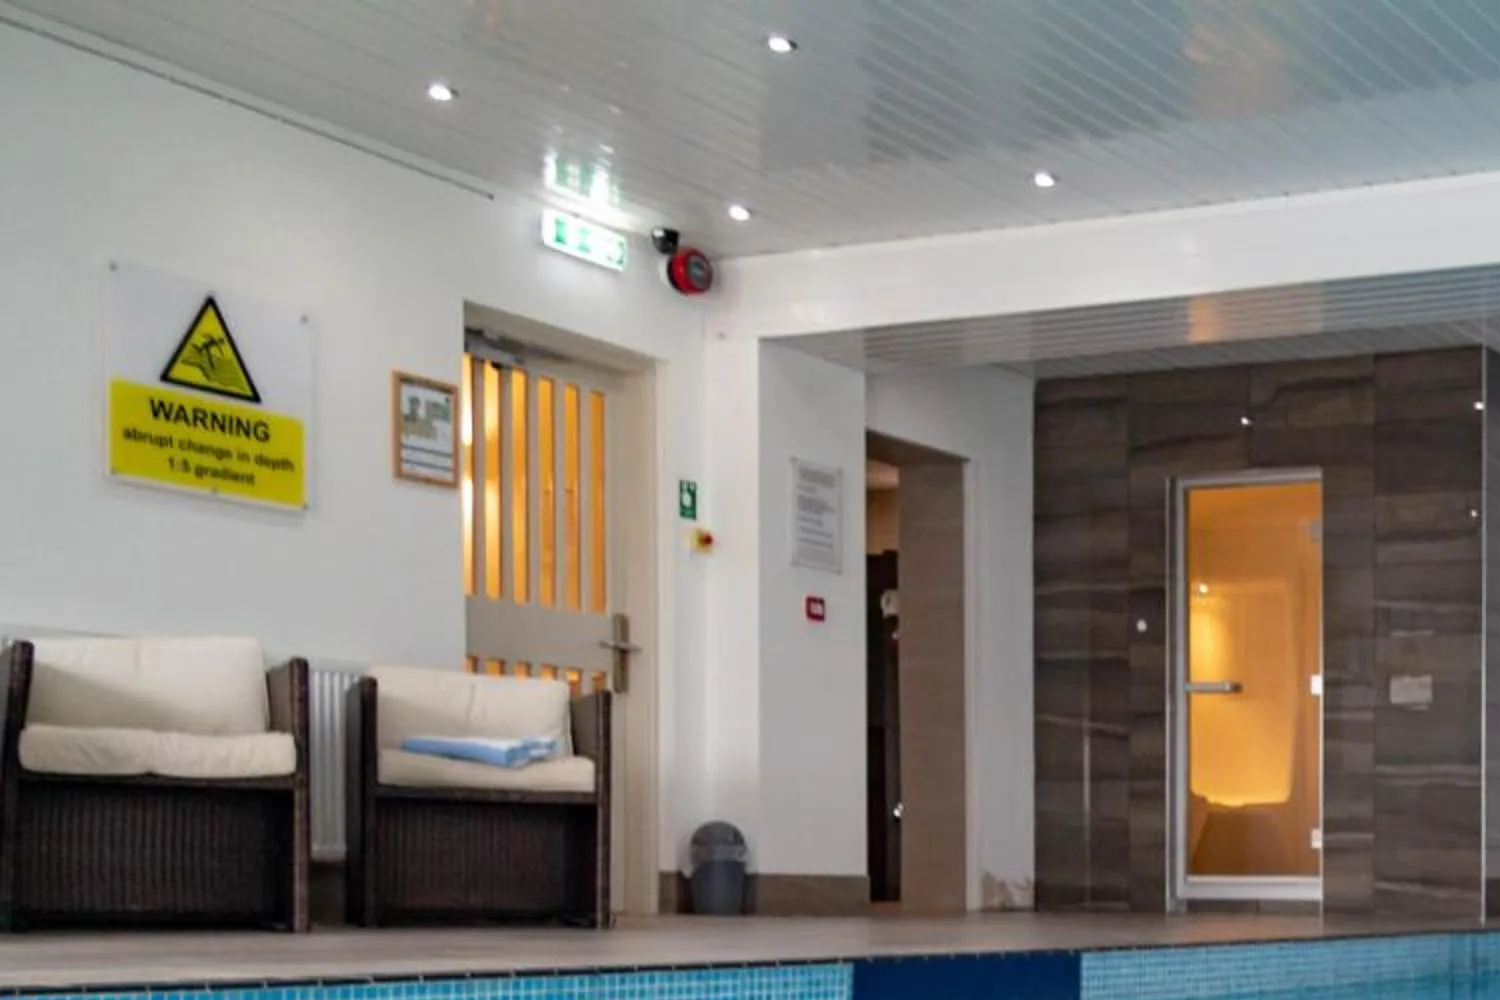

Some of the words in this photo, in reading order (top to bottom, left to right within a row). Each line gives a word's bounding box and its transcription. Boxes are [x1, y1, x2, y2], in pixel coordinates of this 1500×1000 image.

[149, 397, 270, 443] WARNING
[122, 427, 173, 449] abrupt
[177, 438, 232, 461] change
[236, 448, 249, 463] in
[254, 455, 295, 472] depth
[194, 463, 255, 486] gradient
